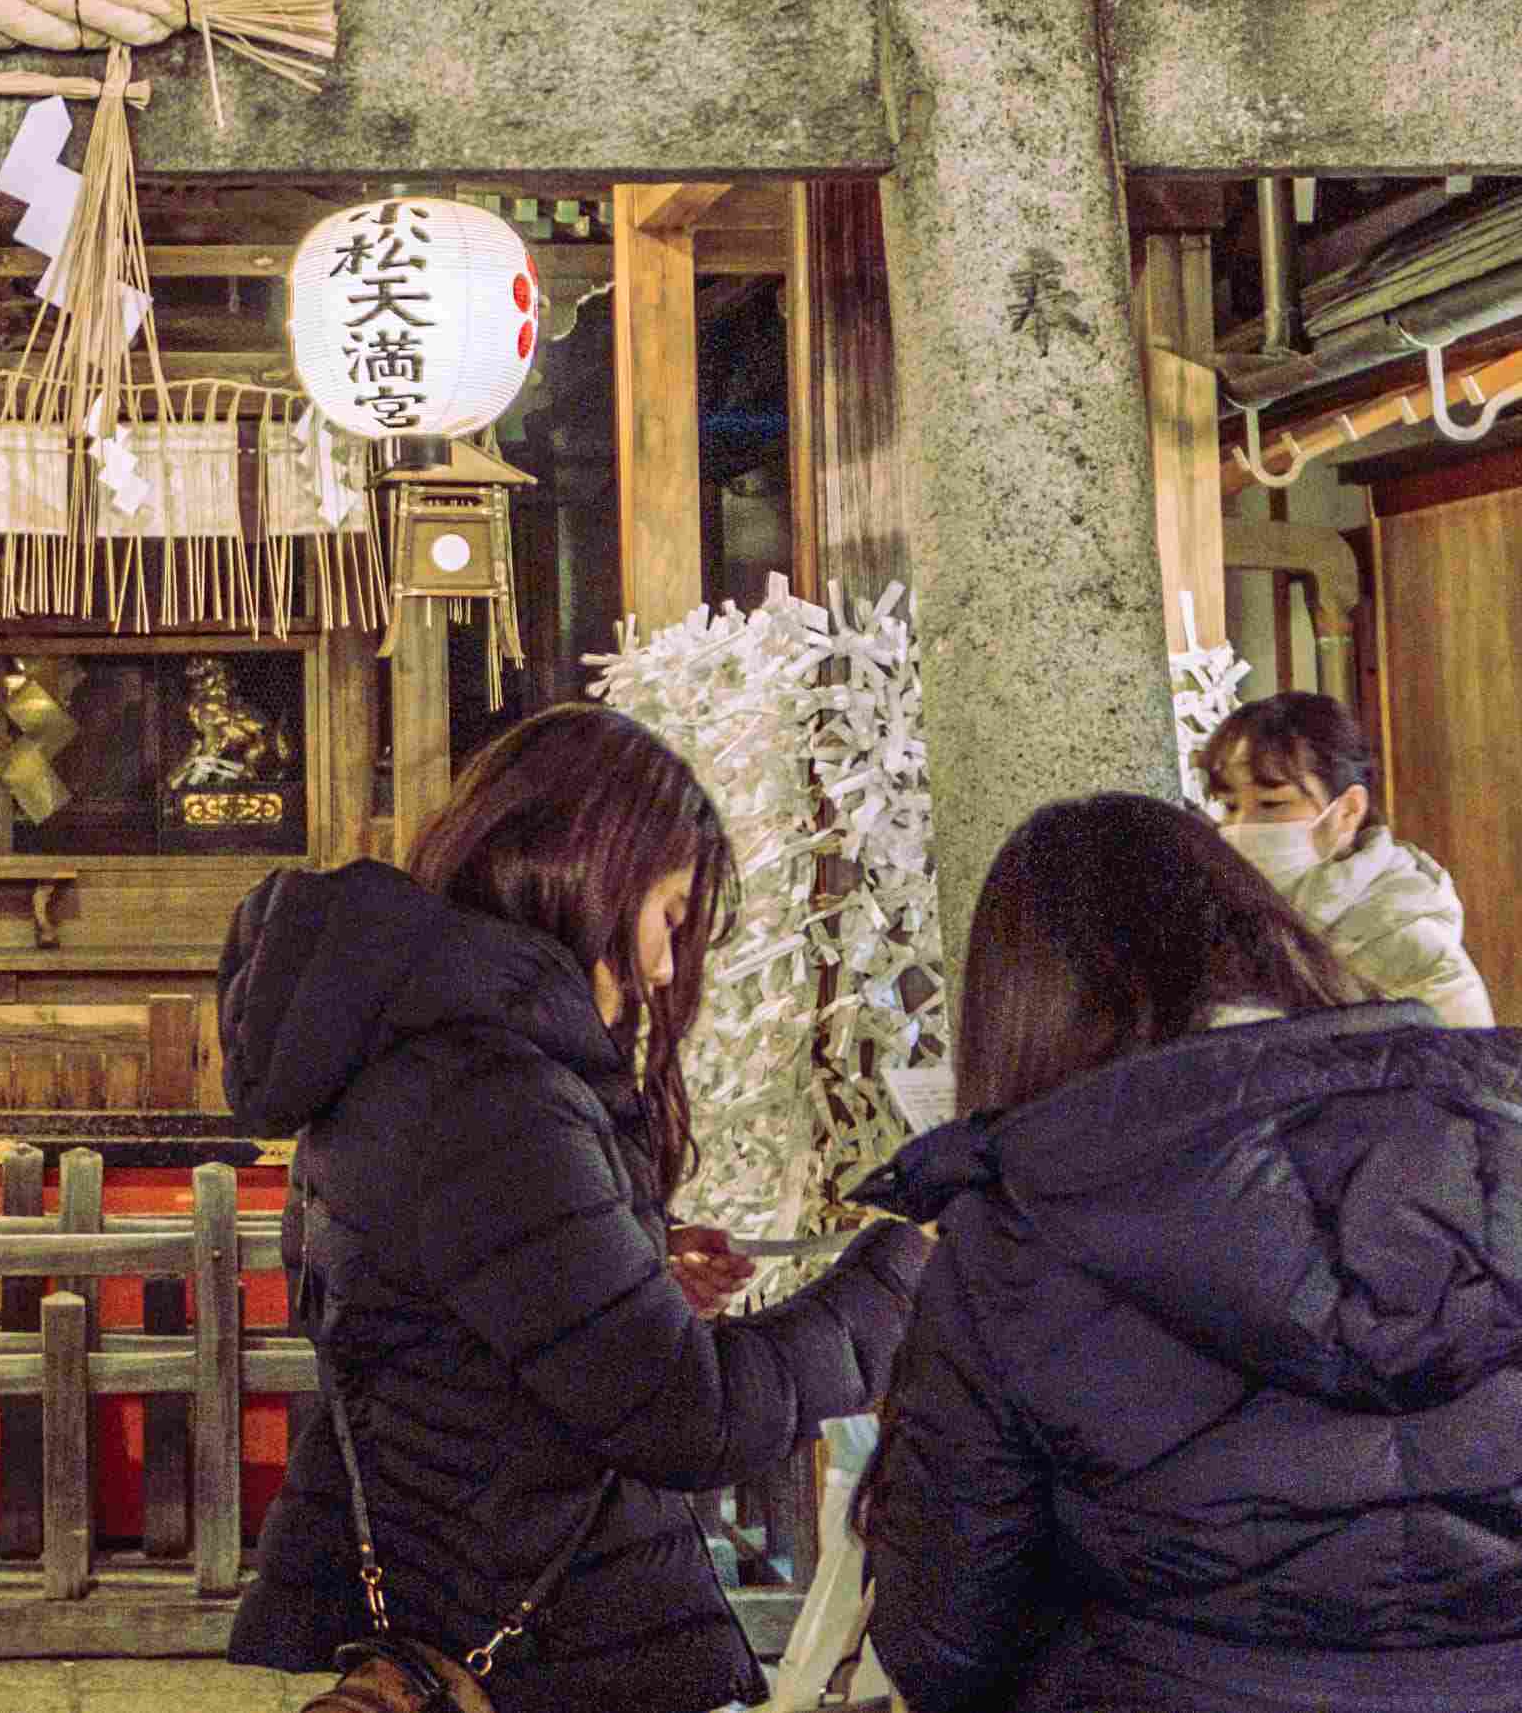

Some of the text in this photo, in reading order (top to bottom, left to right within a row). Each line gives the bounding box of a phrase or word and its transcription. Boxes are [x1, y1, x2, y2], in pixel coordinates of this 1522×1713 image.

[329, 202, 438, 429] 小松天満宮
